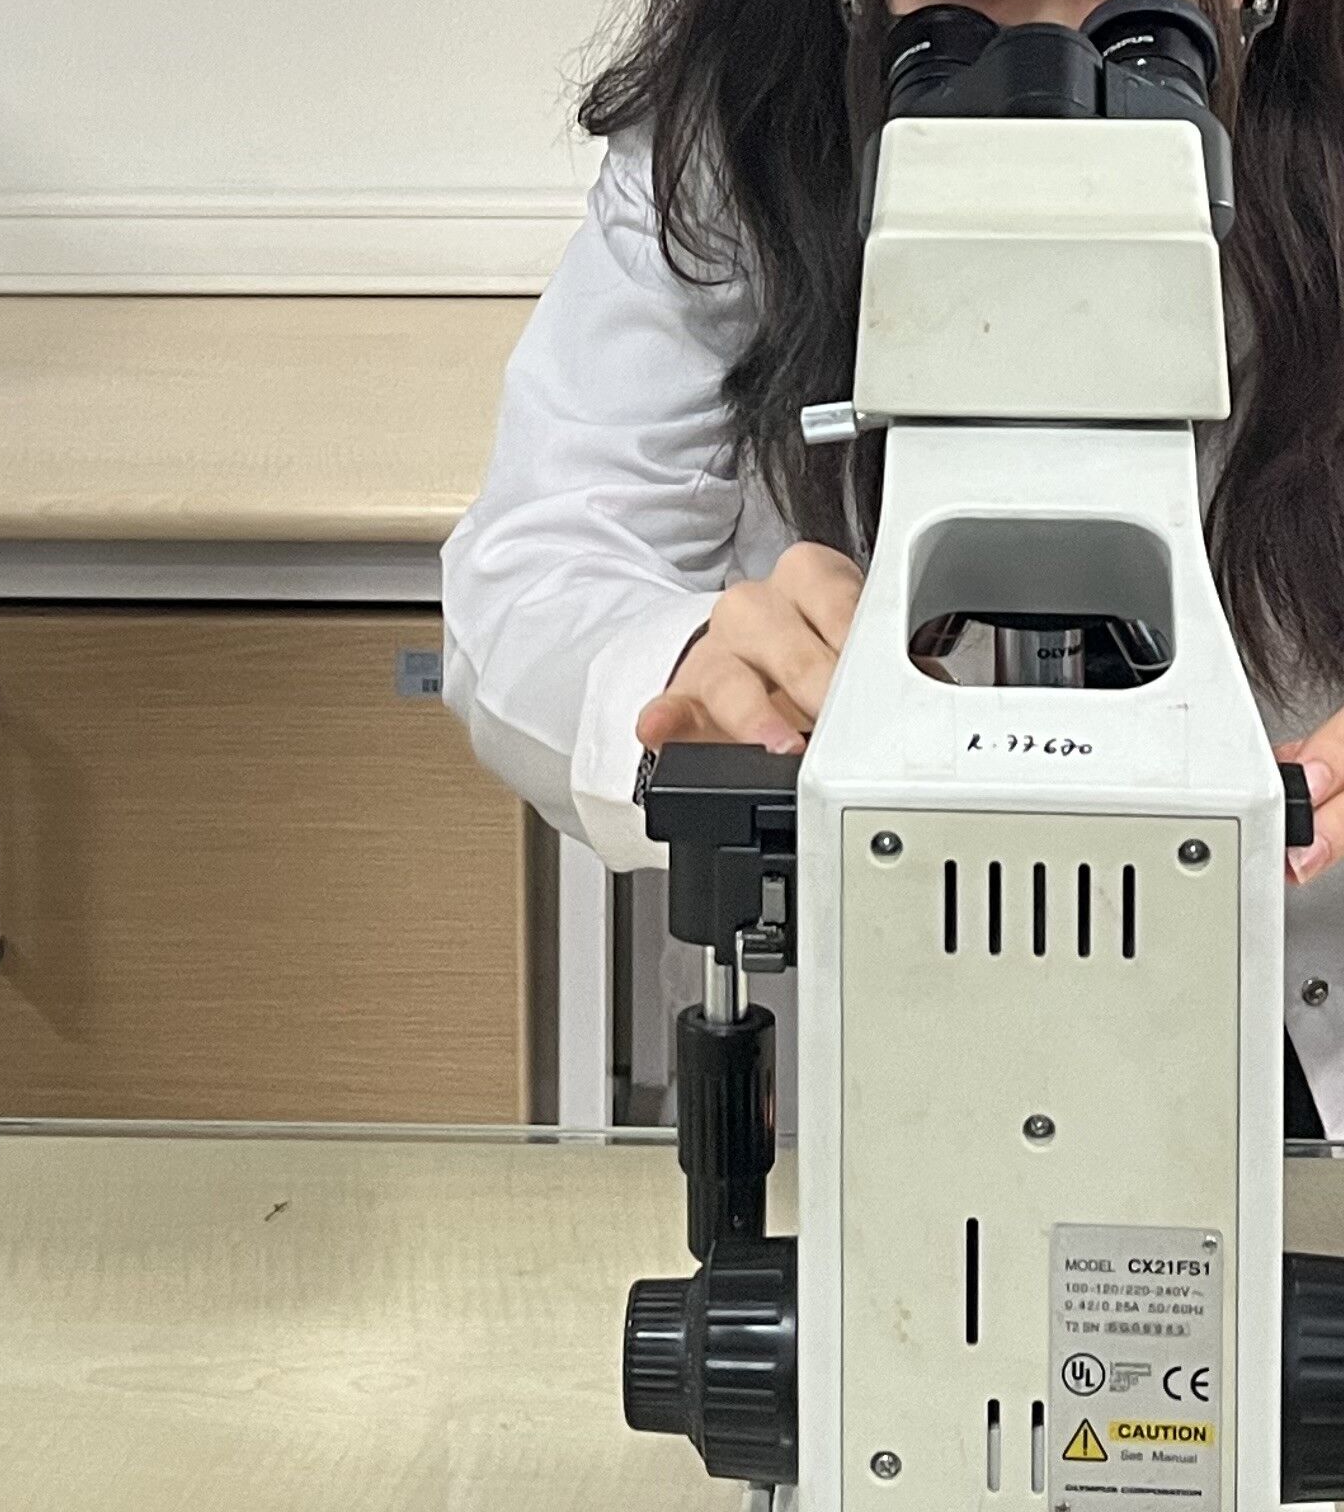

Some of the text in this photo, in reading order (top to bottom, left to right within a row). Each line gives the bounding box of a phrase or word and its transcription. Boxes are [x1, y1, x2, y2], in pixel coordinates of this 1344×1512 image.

[1064, 1257, 1211, 1276] MODEL CX21FS1
[1117, 1423, 1207, 1442] CAUTION
[1151, 1450, 1198, 1464] Manual
